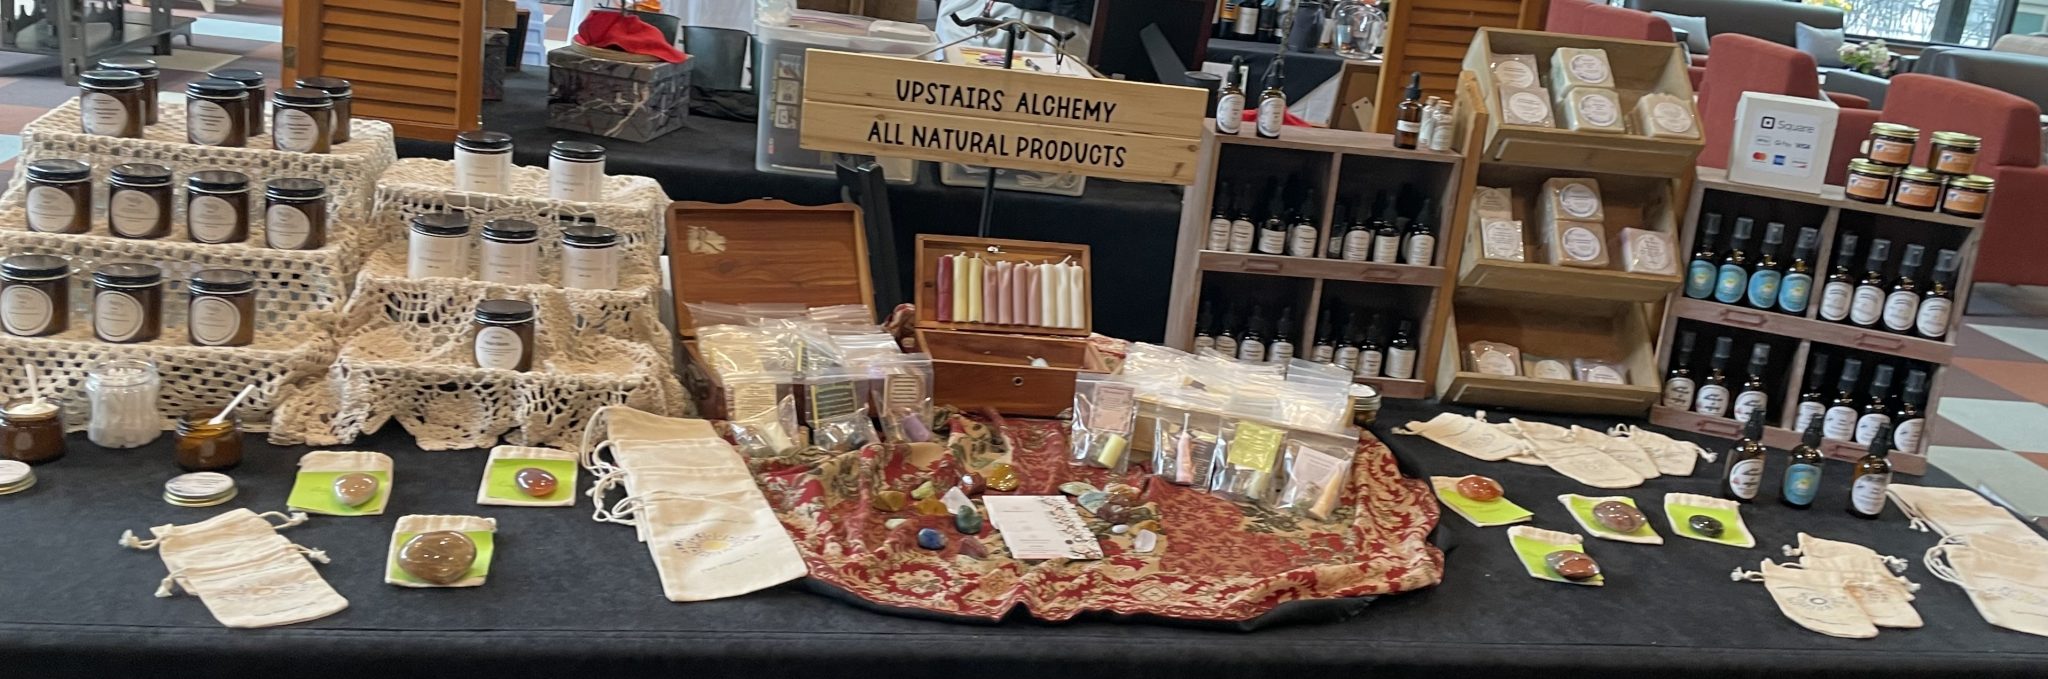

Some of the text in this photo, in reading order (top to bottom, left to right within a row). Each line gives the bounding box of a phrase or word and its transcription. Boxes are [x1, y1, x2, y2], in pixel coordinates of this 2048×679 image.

[896, 79, 1117, 123] UPSTAIRS ALCHEMY
[867, 121, 1127, 168] ALL NATURAL PRODUCTS
[1778, 120, 1814, 133] Square
